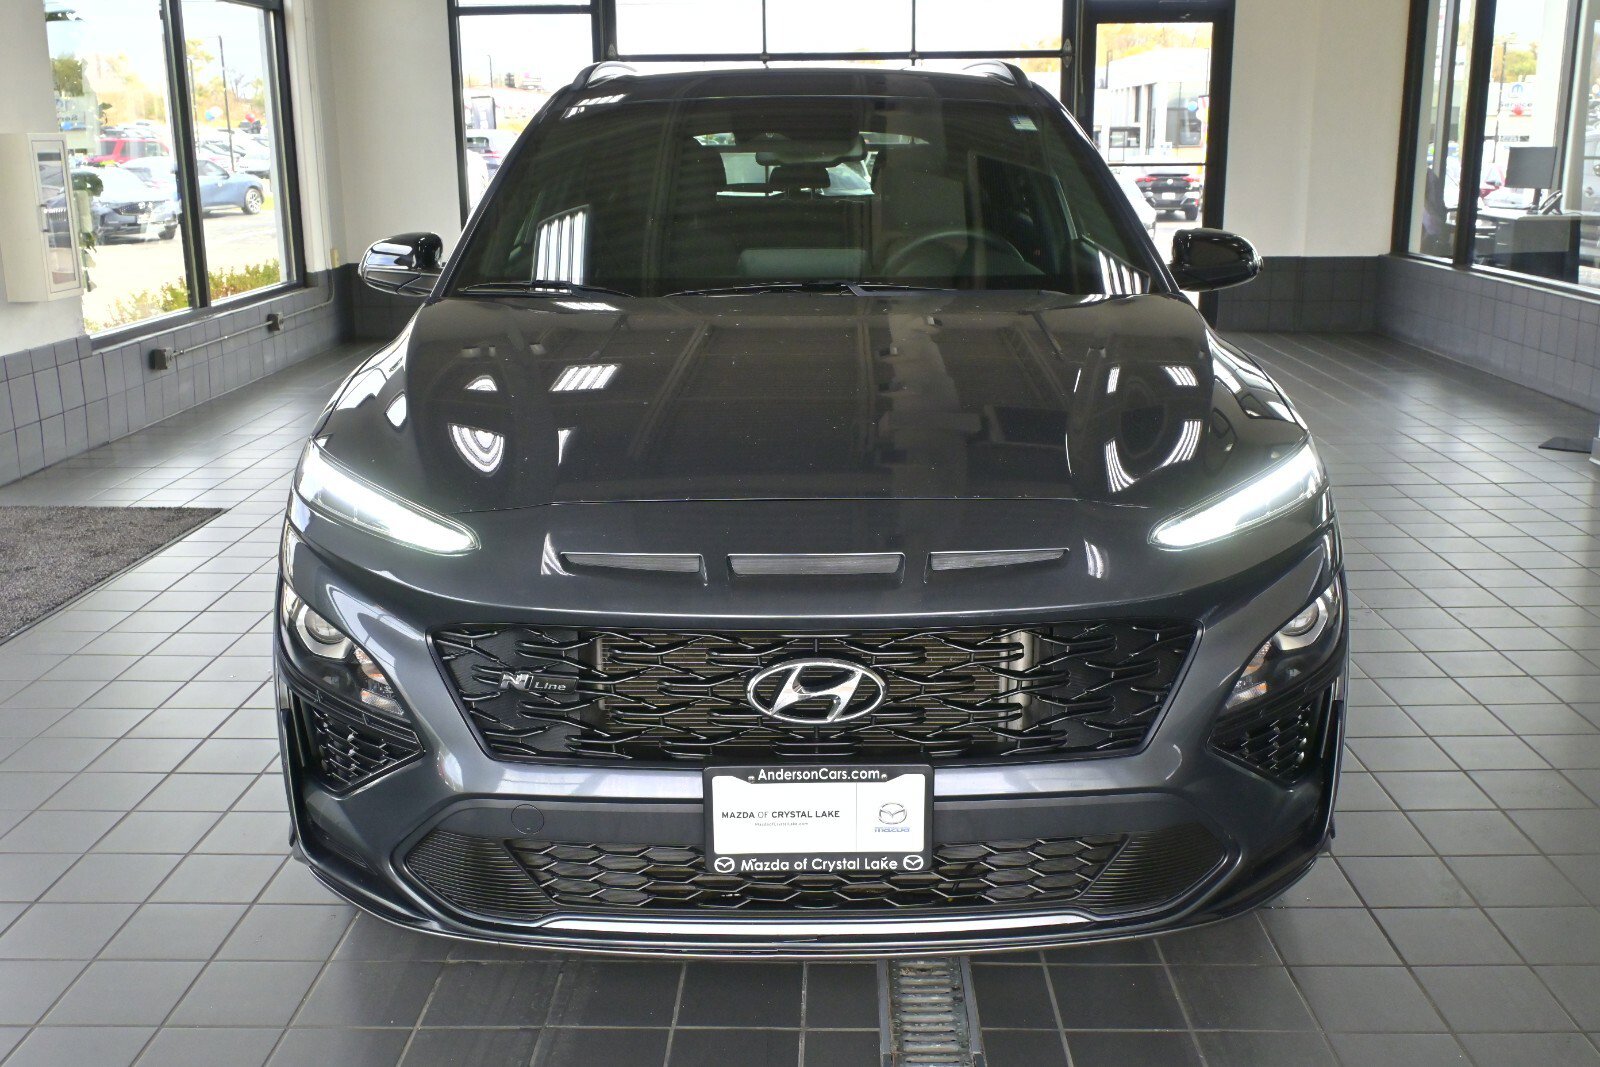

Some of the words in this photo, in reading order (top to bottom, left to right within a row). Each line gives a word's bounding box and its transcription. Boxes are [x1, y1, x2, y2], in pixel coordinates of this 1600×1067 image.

[534, 682, 567, 691] Line
[757, 768, 880, 781] AndersonCars.com
[721, 811, 756, 819] MAZDA
[757, 811, 769, 819] OF
[771, 810, 813, 819] CRYSTAL
[815, 810, 841, 818] LAKE
[740, 858, 790, 871] Mazda
[793, 858, 808, 870] of
[811, 857, 860, 872] Crystal
[864, 857, 899, 870] Lake
